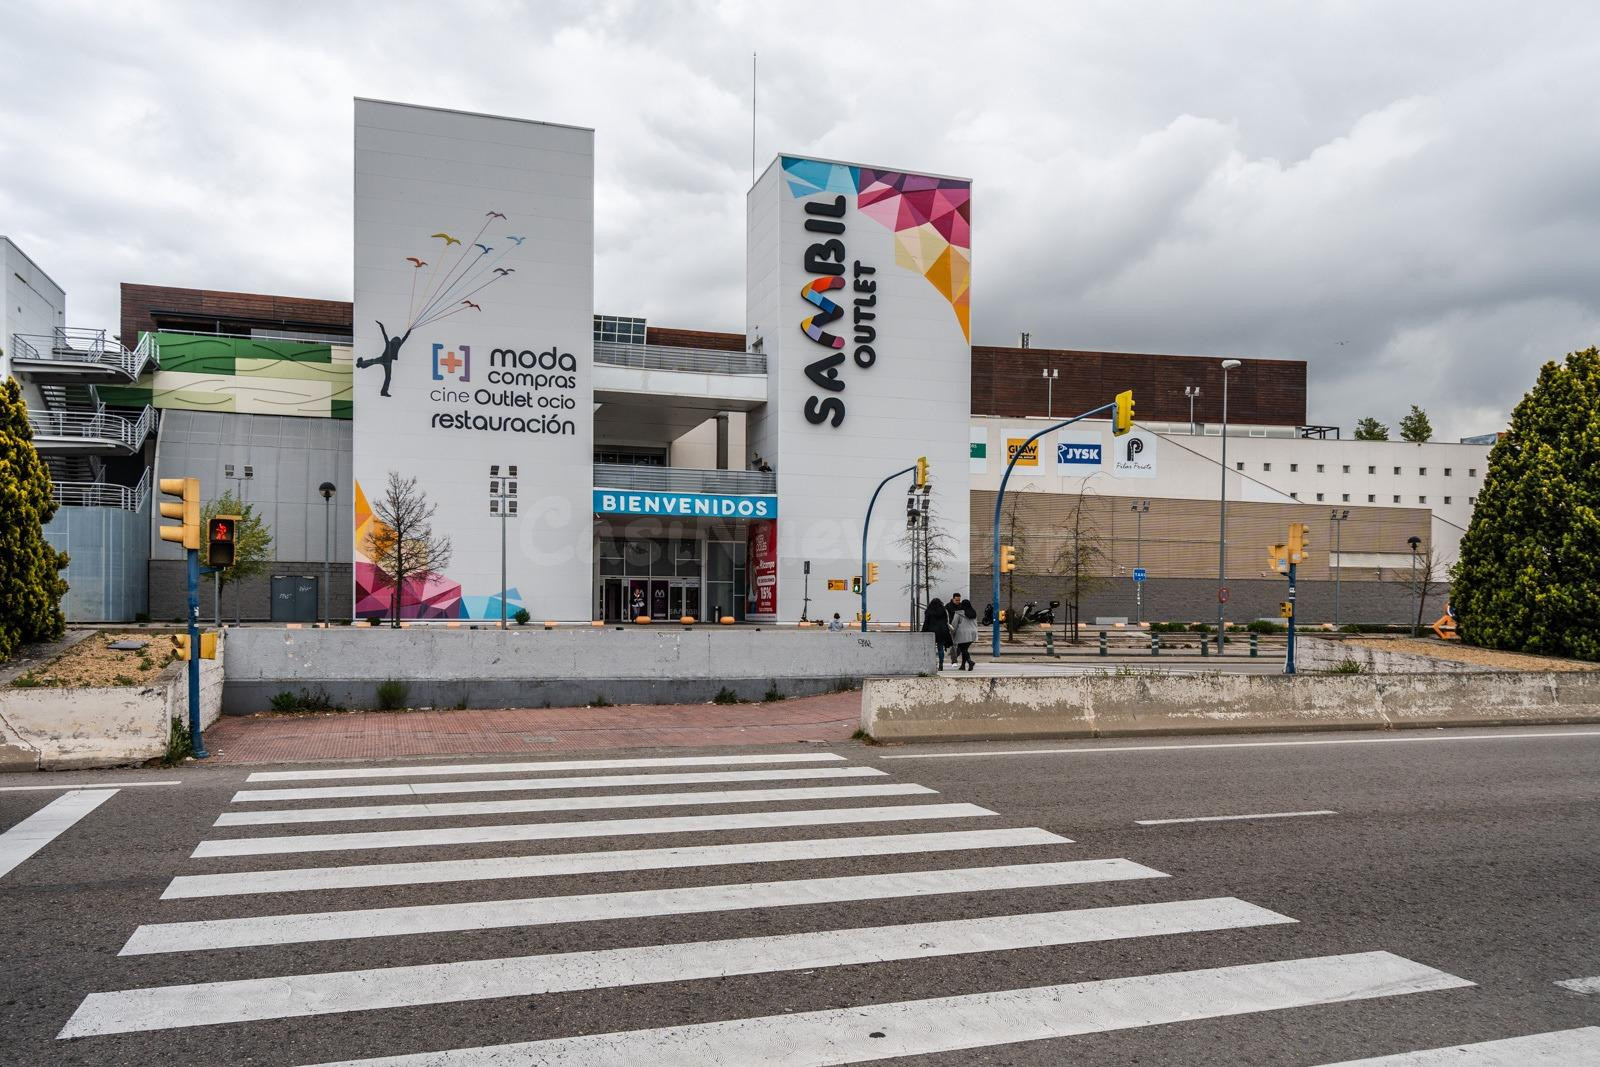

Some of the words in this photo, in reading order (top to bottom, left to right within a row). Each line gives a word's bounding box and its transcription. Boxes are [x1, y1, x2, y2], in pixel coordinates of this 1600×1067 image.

[800, 194, 847, 428] SAMBIL
[853, 260, 877, 369] OUTLET
[490, 346, 577, 372] moda
[488, 370, 576, 390] compras
[430, 387, 470, 403] cine
[474, 388, 534, 408] Outlet
[537, 394, 576, 410] ocio
[431, 410, 576, 435] restauración
[1066, 448, 1099, 460] JYSK
[602, 495, 768, 516] BIENVENIDOS
